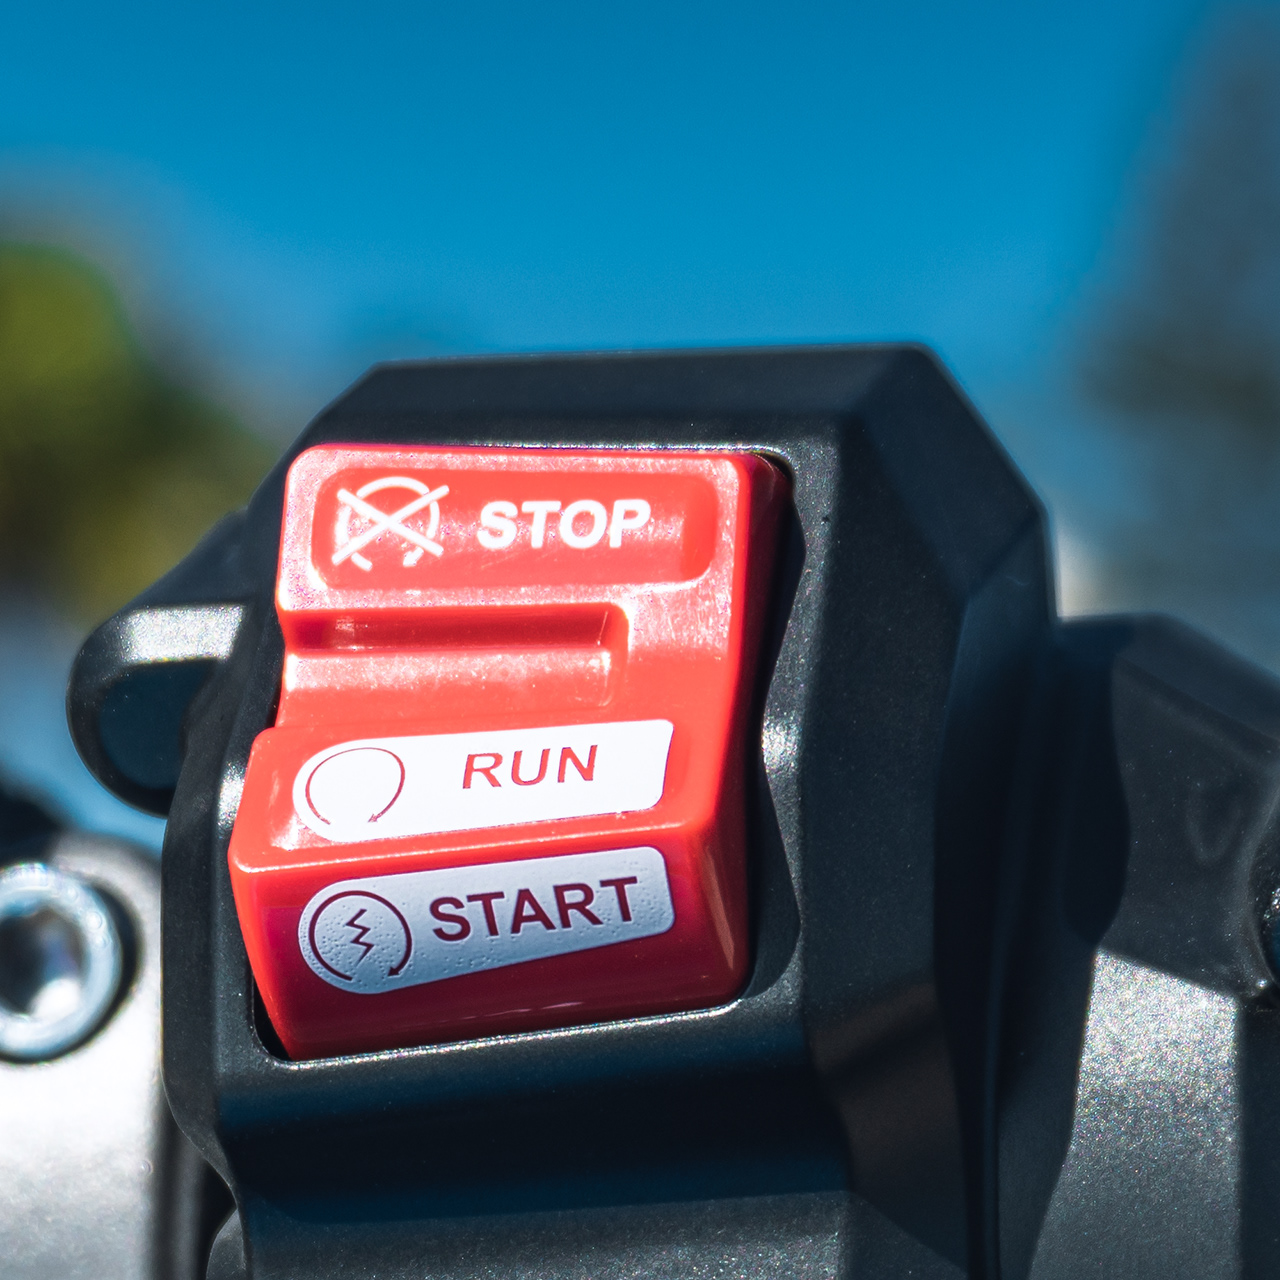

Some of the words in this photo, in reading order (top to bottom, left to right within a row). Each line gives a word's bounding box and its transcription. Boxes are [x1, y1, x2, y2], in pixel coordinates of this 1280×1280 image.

[477, 500, 651, 548] STOP
[463, 745, 598, 789] RUN
[429, 876, 638, 942] START
